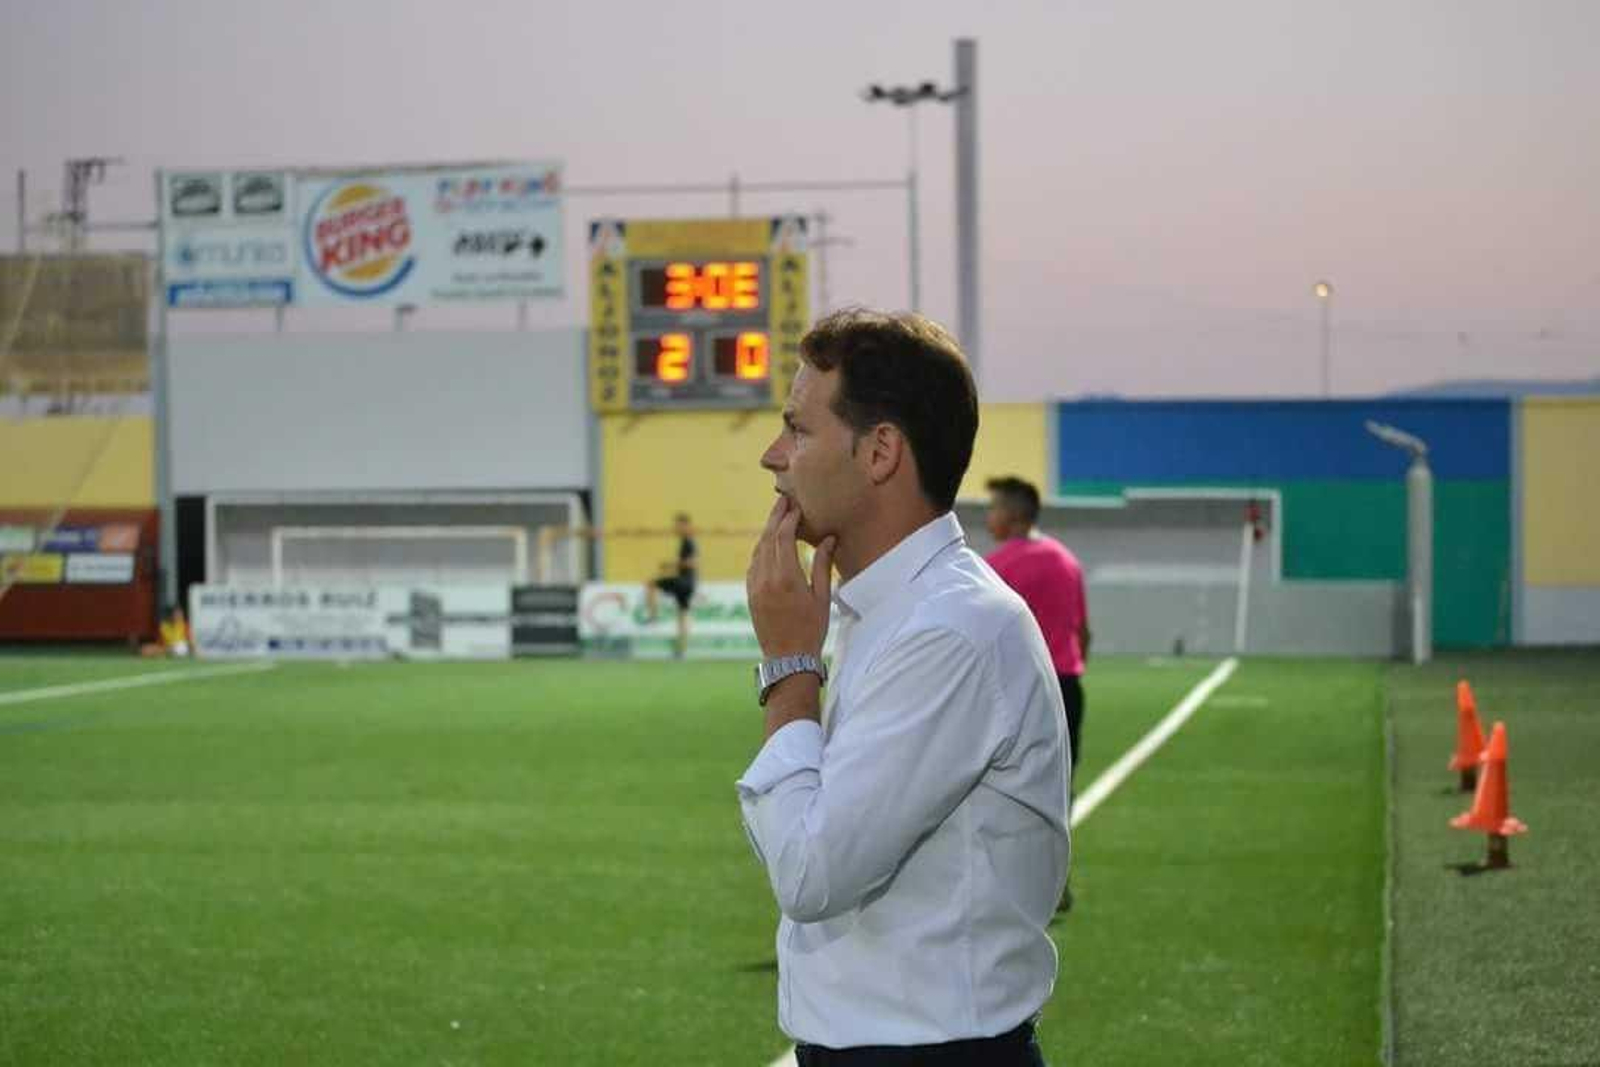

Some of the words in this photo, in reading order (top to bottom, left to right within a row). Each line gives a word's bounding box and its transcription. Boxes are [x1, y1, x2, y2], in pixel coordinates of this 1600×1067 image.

[315, 196, 405, 242] BURGER
[320, 217, 411, 274] KING
[658, 331, 692, 383] 2
[736, 330, 770, 380] 0
[200, 589, 311, 608] HIERROS
[318, 588, 378, 609] RUIZ
